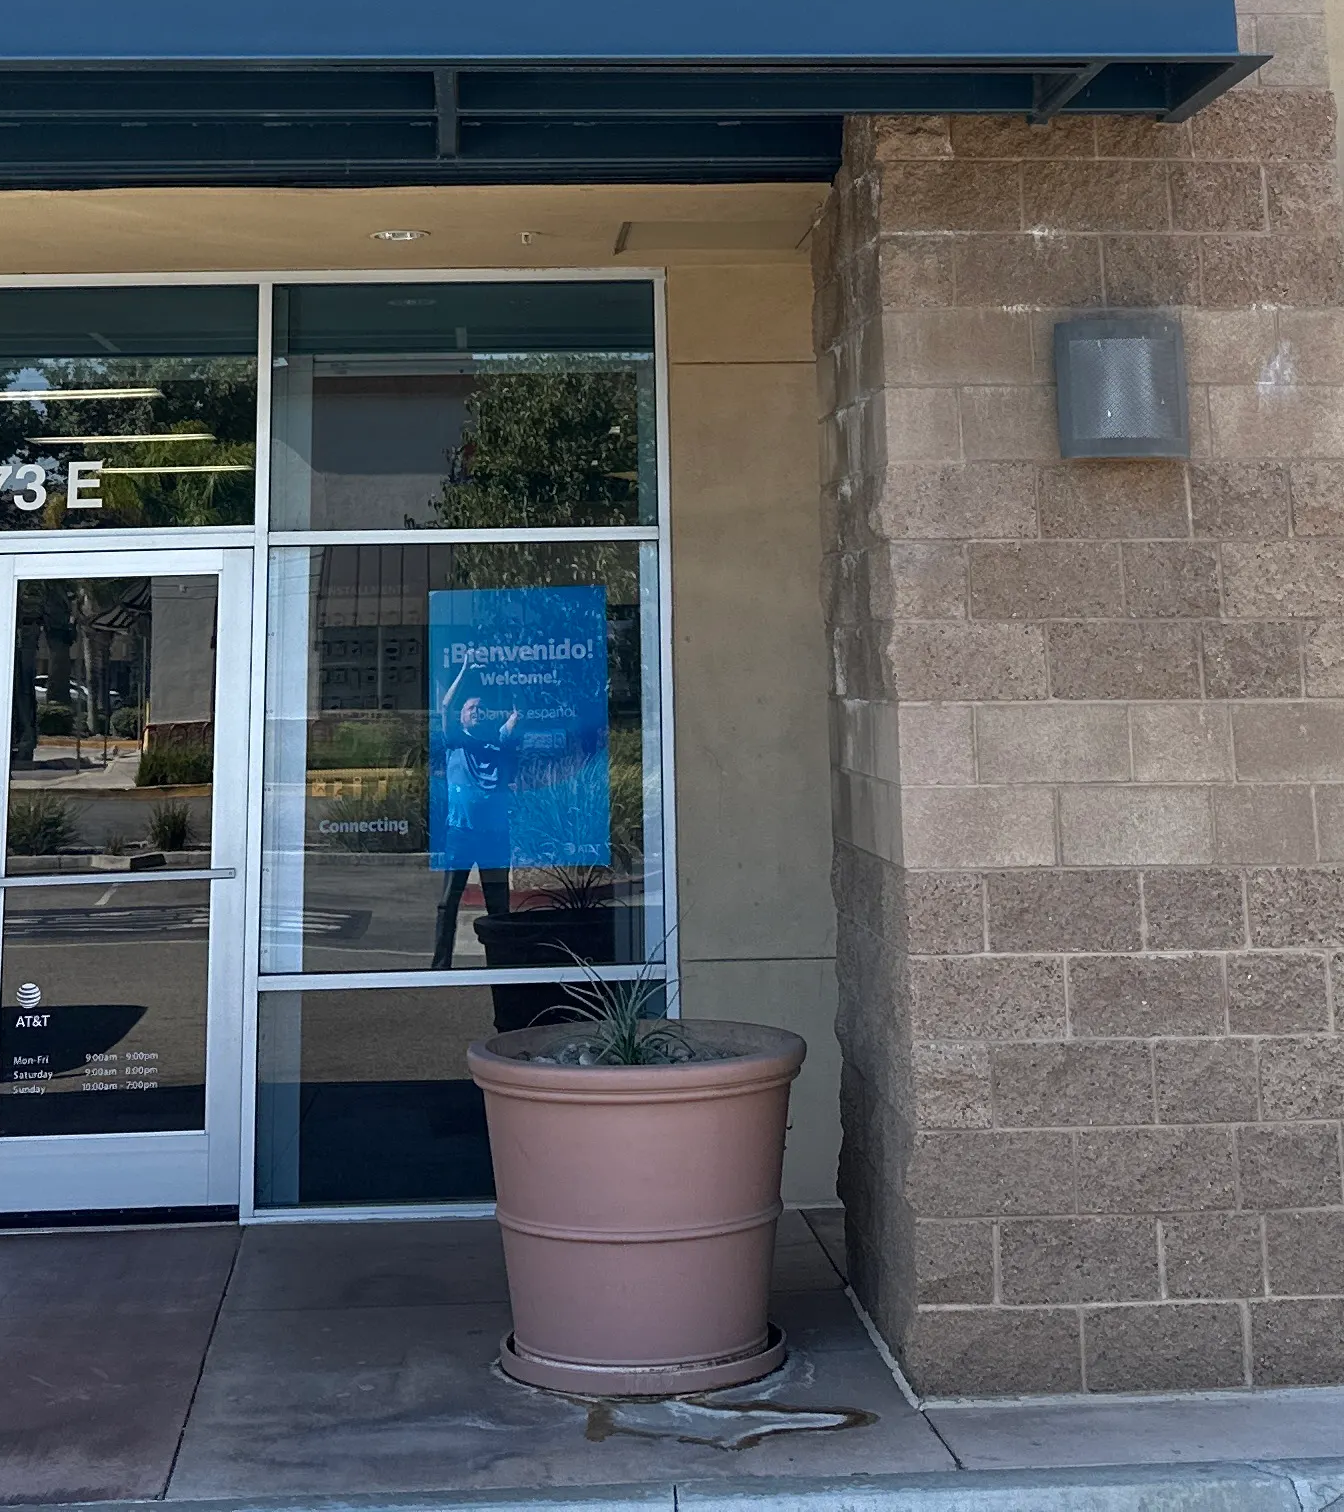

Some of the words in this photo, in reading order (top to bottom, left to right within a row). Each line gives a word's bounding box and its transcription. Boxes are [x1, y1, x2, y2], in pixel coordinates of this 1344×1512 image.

[67, 461, 104, 508] E
[443, 639, 595, 669] ¡Bienvenido!
[480, 670, 557, 686] Welcome!
[319, 818, 409, 835] Connecting
[15, 1014, 51, 1028] AT&T
[13, 1055, 49, 1066] Mon-Fri
[125, 1051, 159, 1062] 9:00pm
[13, 1070, 53, 1081] Saturday
[12, 1085, 46, 1096] Sunday
